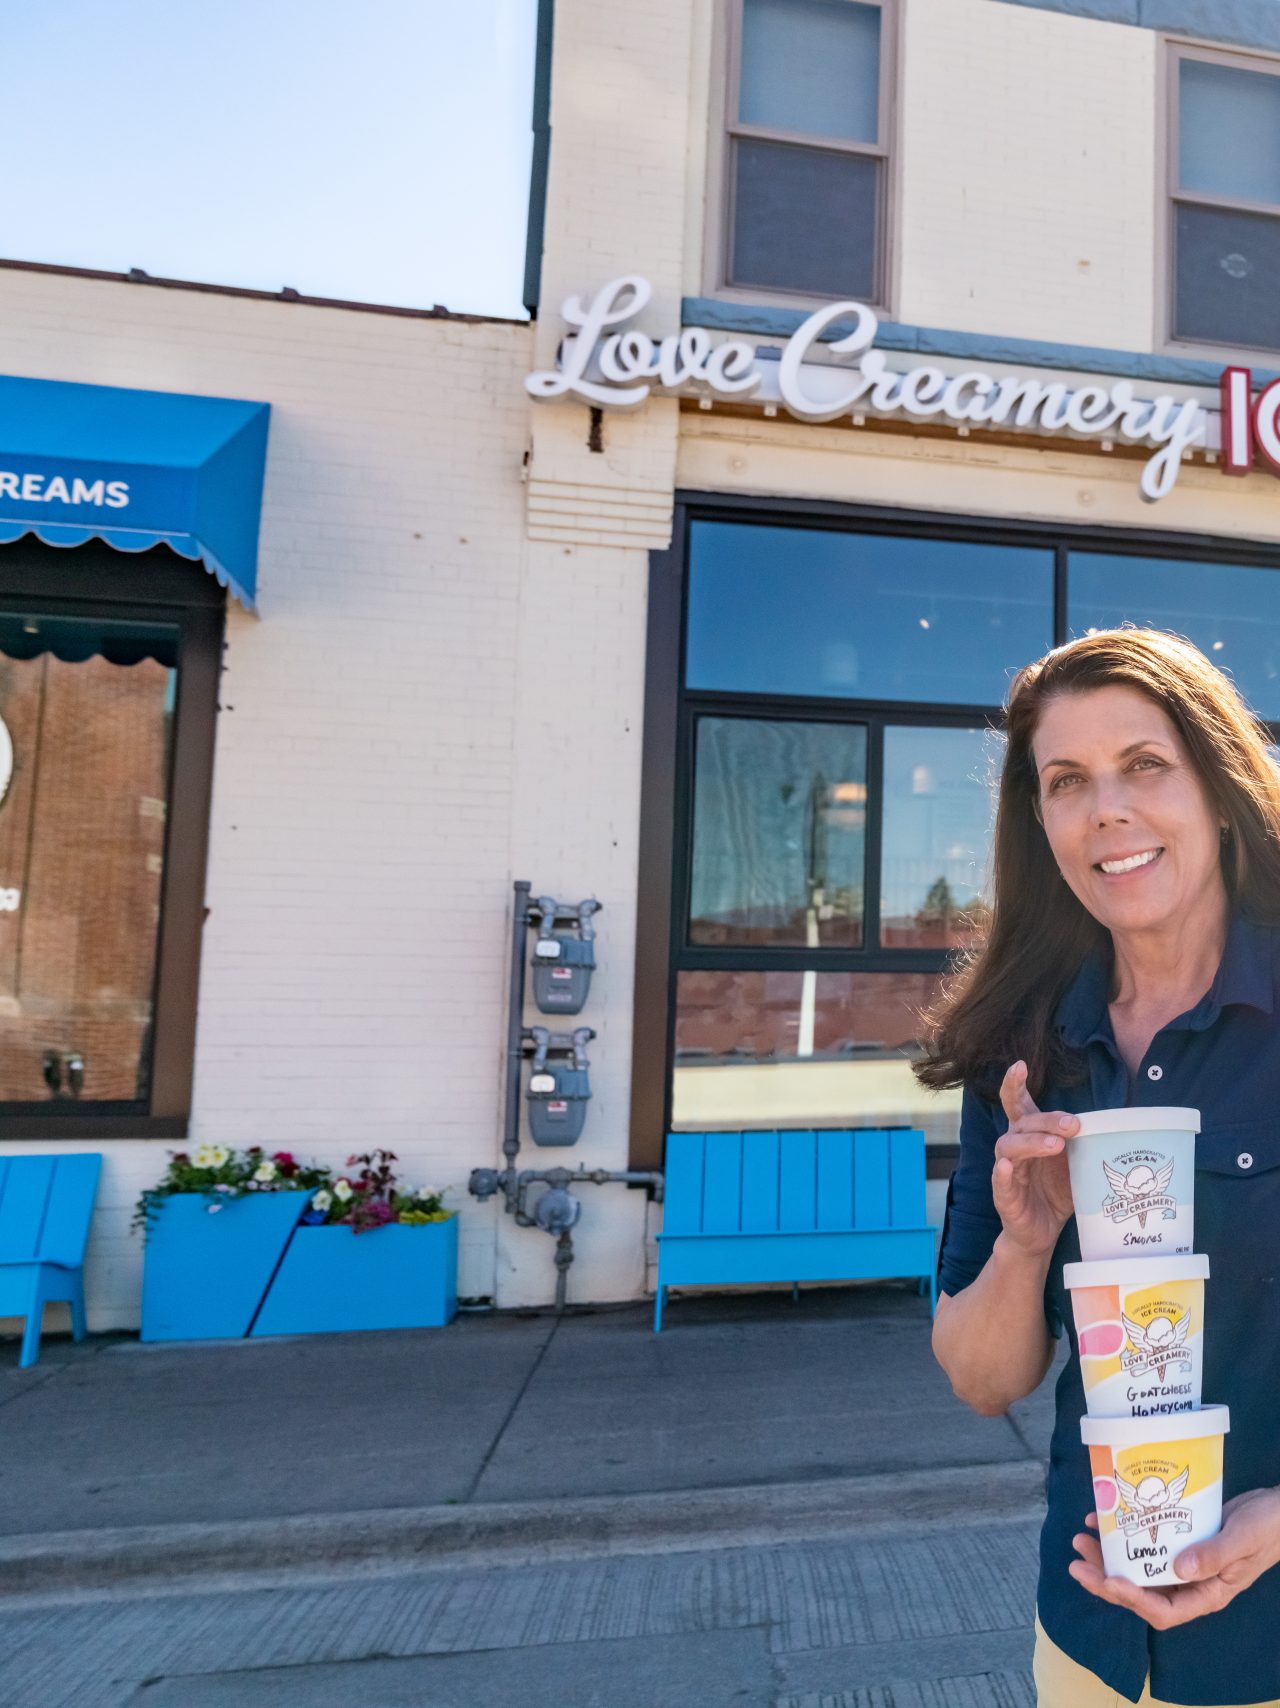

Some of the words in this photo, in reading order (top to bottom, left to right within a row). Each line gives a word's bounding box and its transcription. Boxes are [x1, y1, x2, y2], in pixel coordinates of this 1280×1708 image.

[524, 276, 763, 410] Love
[778, 301, 1206, 503] Creamery
[1121, 1155, 1157, 1165] VEGAN
[1105, 1201, 1126, 1214] LOVE
[1129, 1198, 1174, 1213] CREAMERY
[1141, 1309, 1152, 1318] ICE
[1153, 1307, 1177, 1316] CREAM
[1123, 1354, 1144, 1368] LOVE
[1148, 1350, 1191, 1367] CREAMERY
[1131, 1467, 1142, 1477] ICE
[1143, 1466, 1169, 1474] CREAM
[1118, 1515, 1135, 1526] LOVE
[1140, 1511, 1189, 1527] CREAMERY
[1126, 1538, 1168, 1561] Lemon
[1144, 1561, 1169, 1578] Bar
